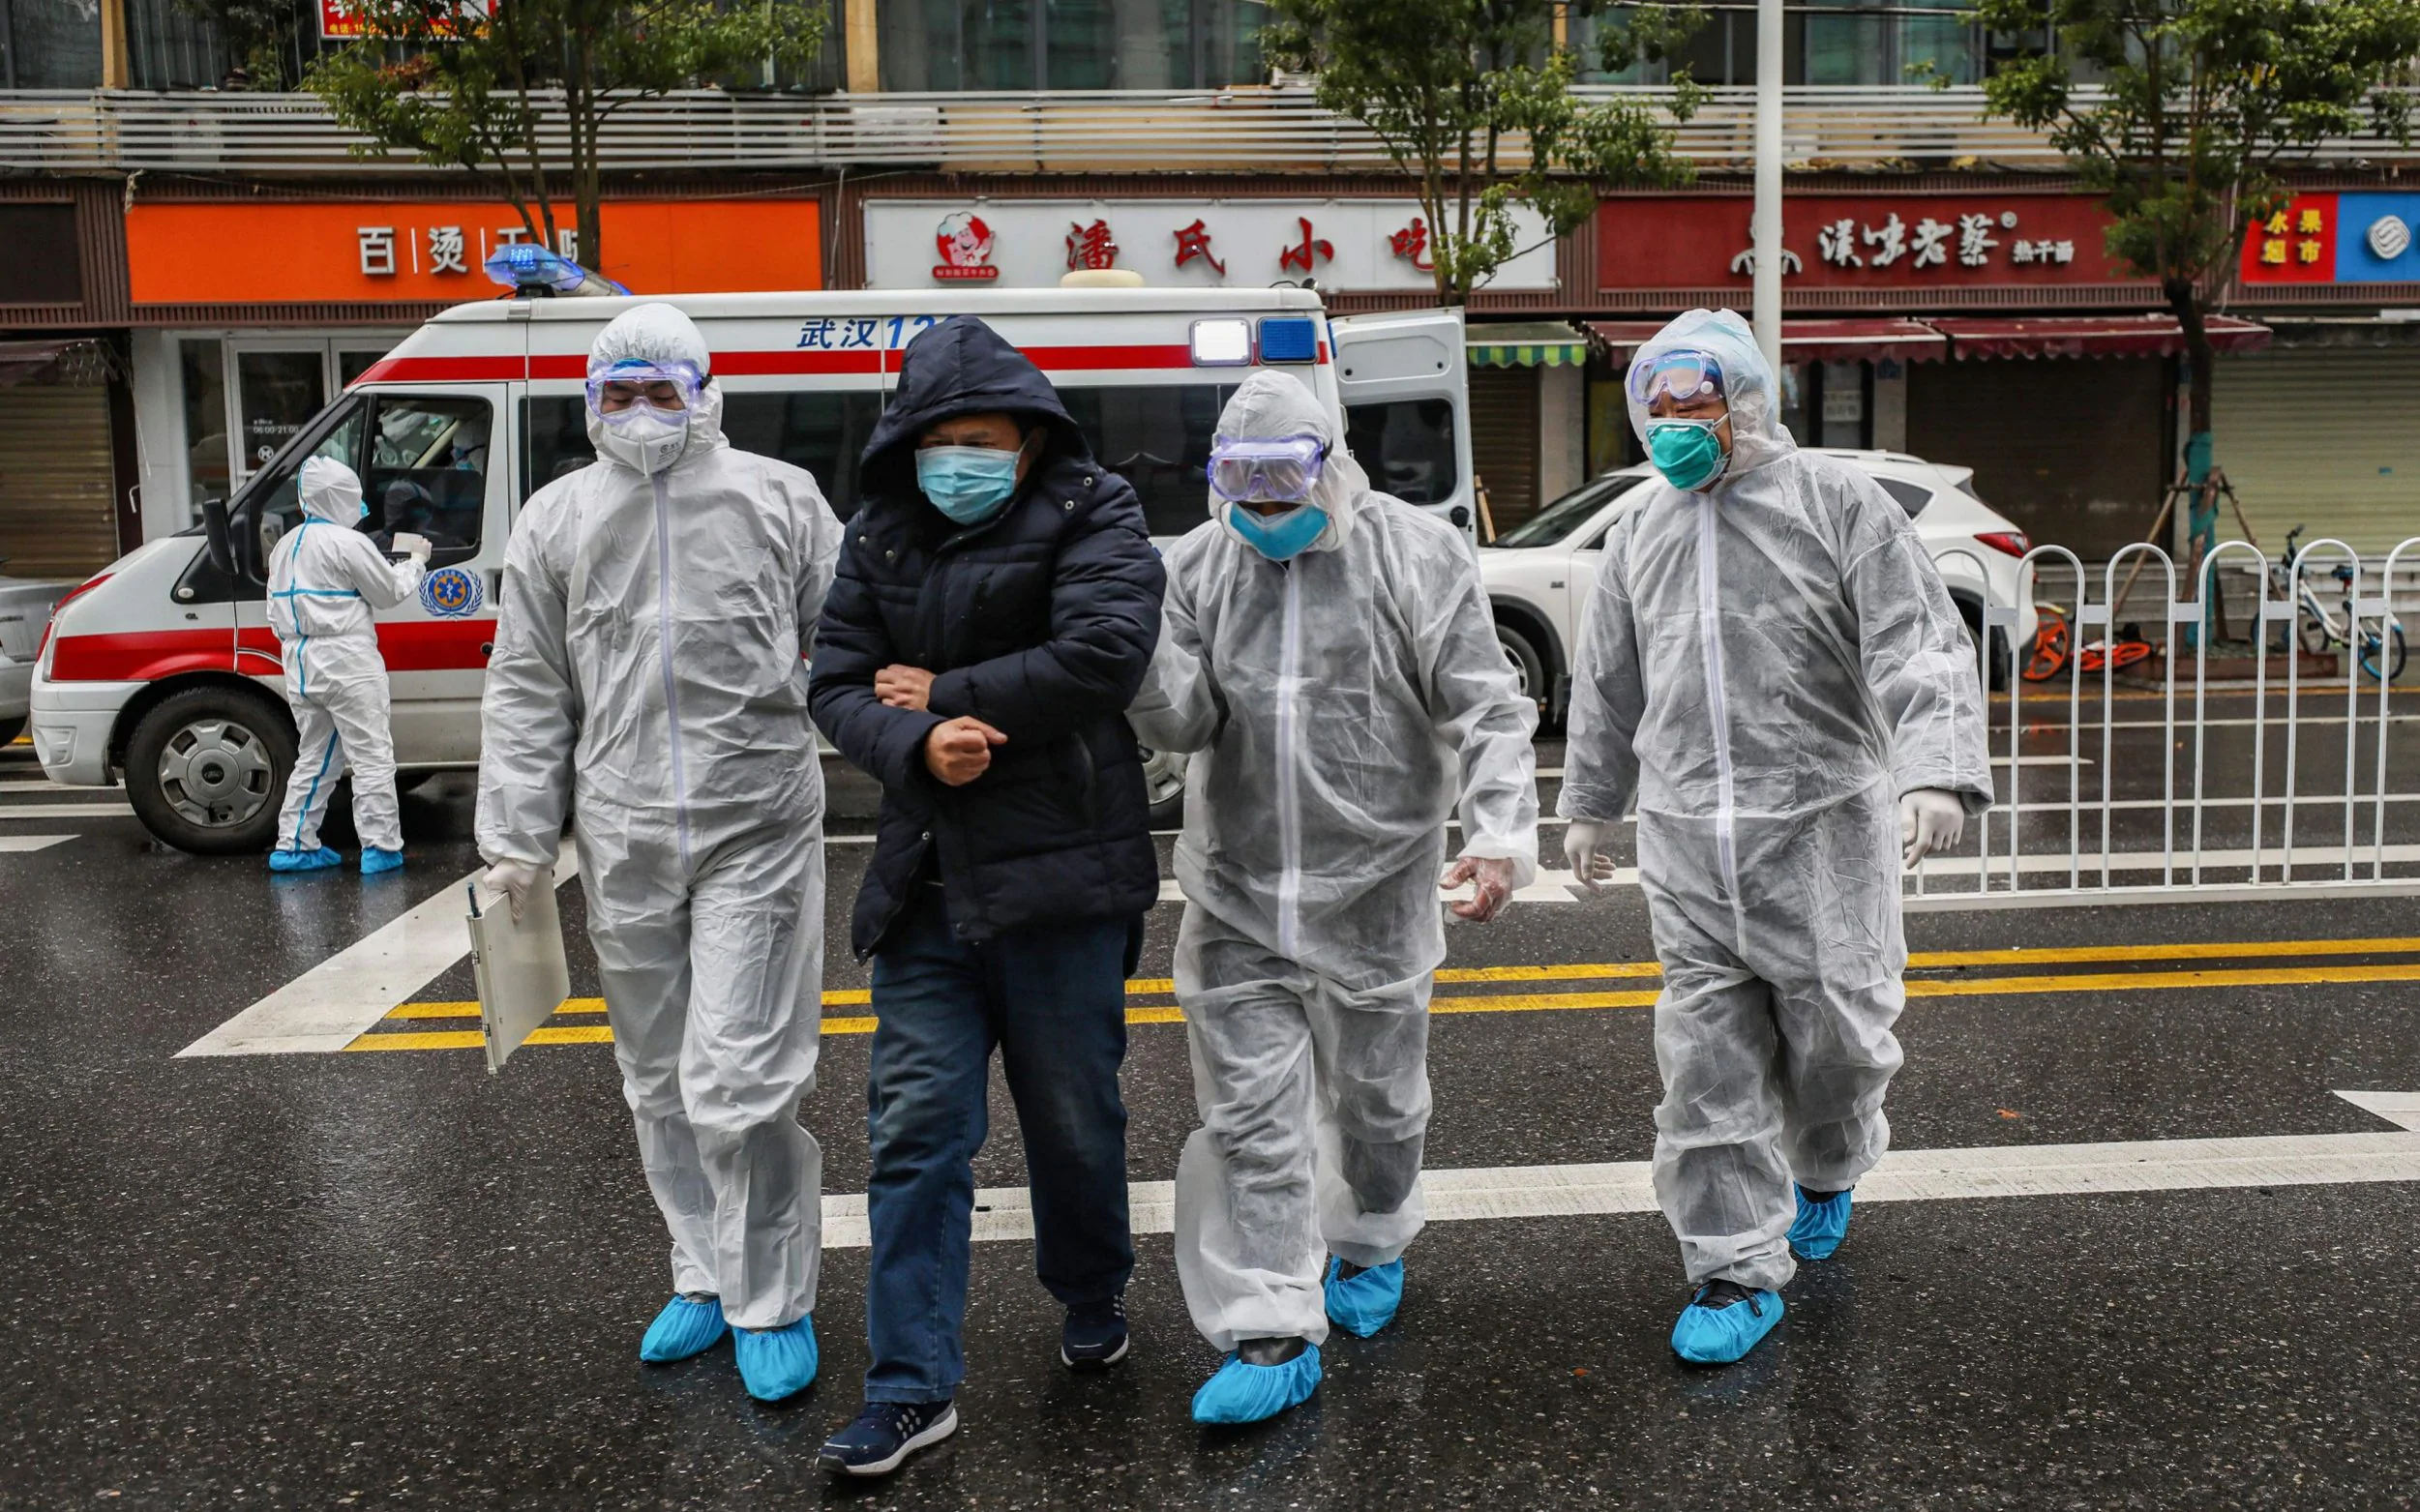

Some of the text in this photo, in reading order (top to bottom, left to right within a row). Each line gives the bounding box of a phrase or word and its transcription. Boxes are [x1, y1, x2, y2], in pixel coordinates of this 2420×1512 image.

[2263, 209, 2321, 234] 水果
[1065, 217, 1436, 277] 潘氏小吃
[2261, 239, 2321, 263] 超市
